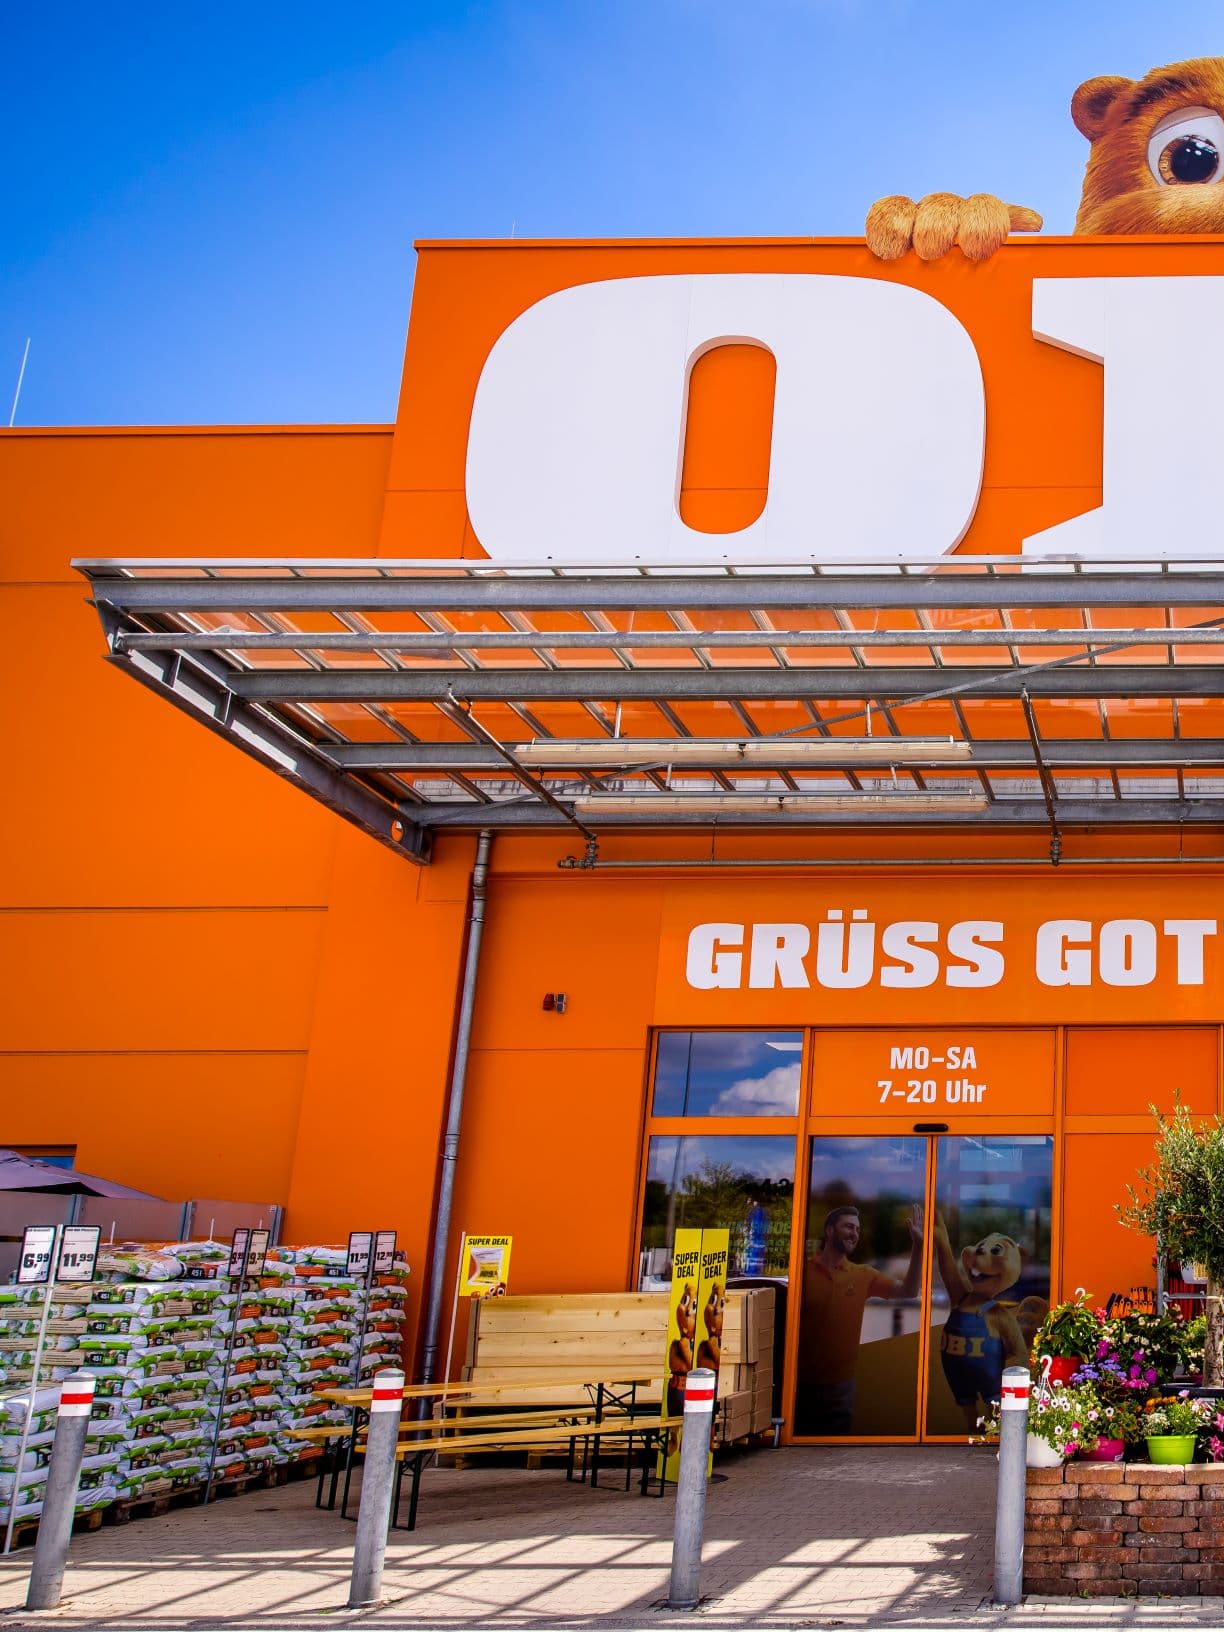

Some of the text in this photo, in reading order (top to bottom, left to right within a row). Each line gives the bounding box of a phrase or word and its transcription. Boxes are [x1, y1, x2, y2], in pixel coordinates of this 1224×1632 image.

[686, 909, 1005, 989] GRÜSS
[889, 1046, 977, 1070] MO-SA
[877, 1079, 987, 1104] 7-20 Uhr
[467, 1238, 509, 1246] SUPER DEAL
[23, 1253, 50, 1269] 6,99
[63, 1253, 95, 1267] 11,99
[674, 1251, 699, 1266] SUPER
[702, 1250, 727, 1267] SUPER
[676, 1265, 695, 1279] DEAL
[704, 1265, 722, 1279] DEAL
